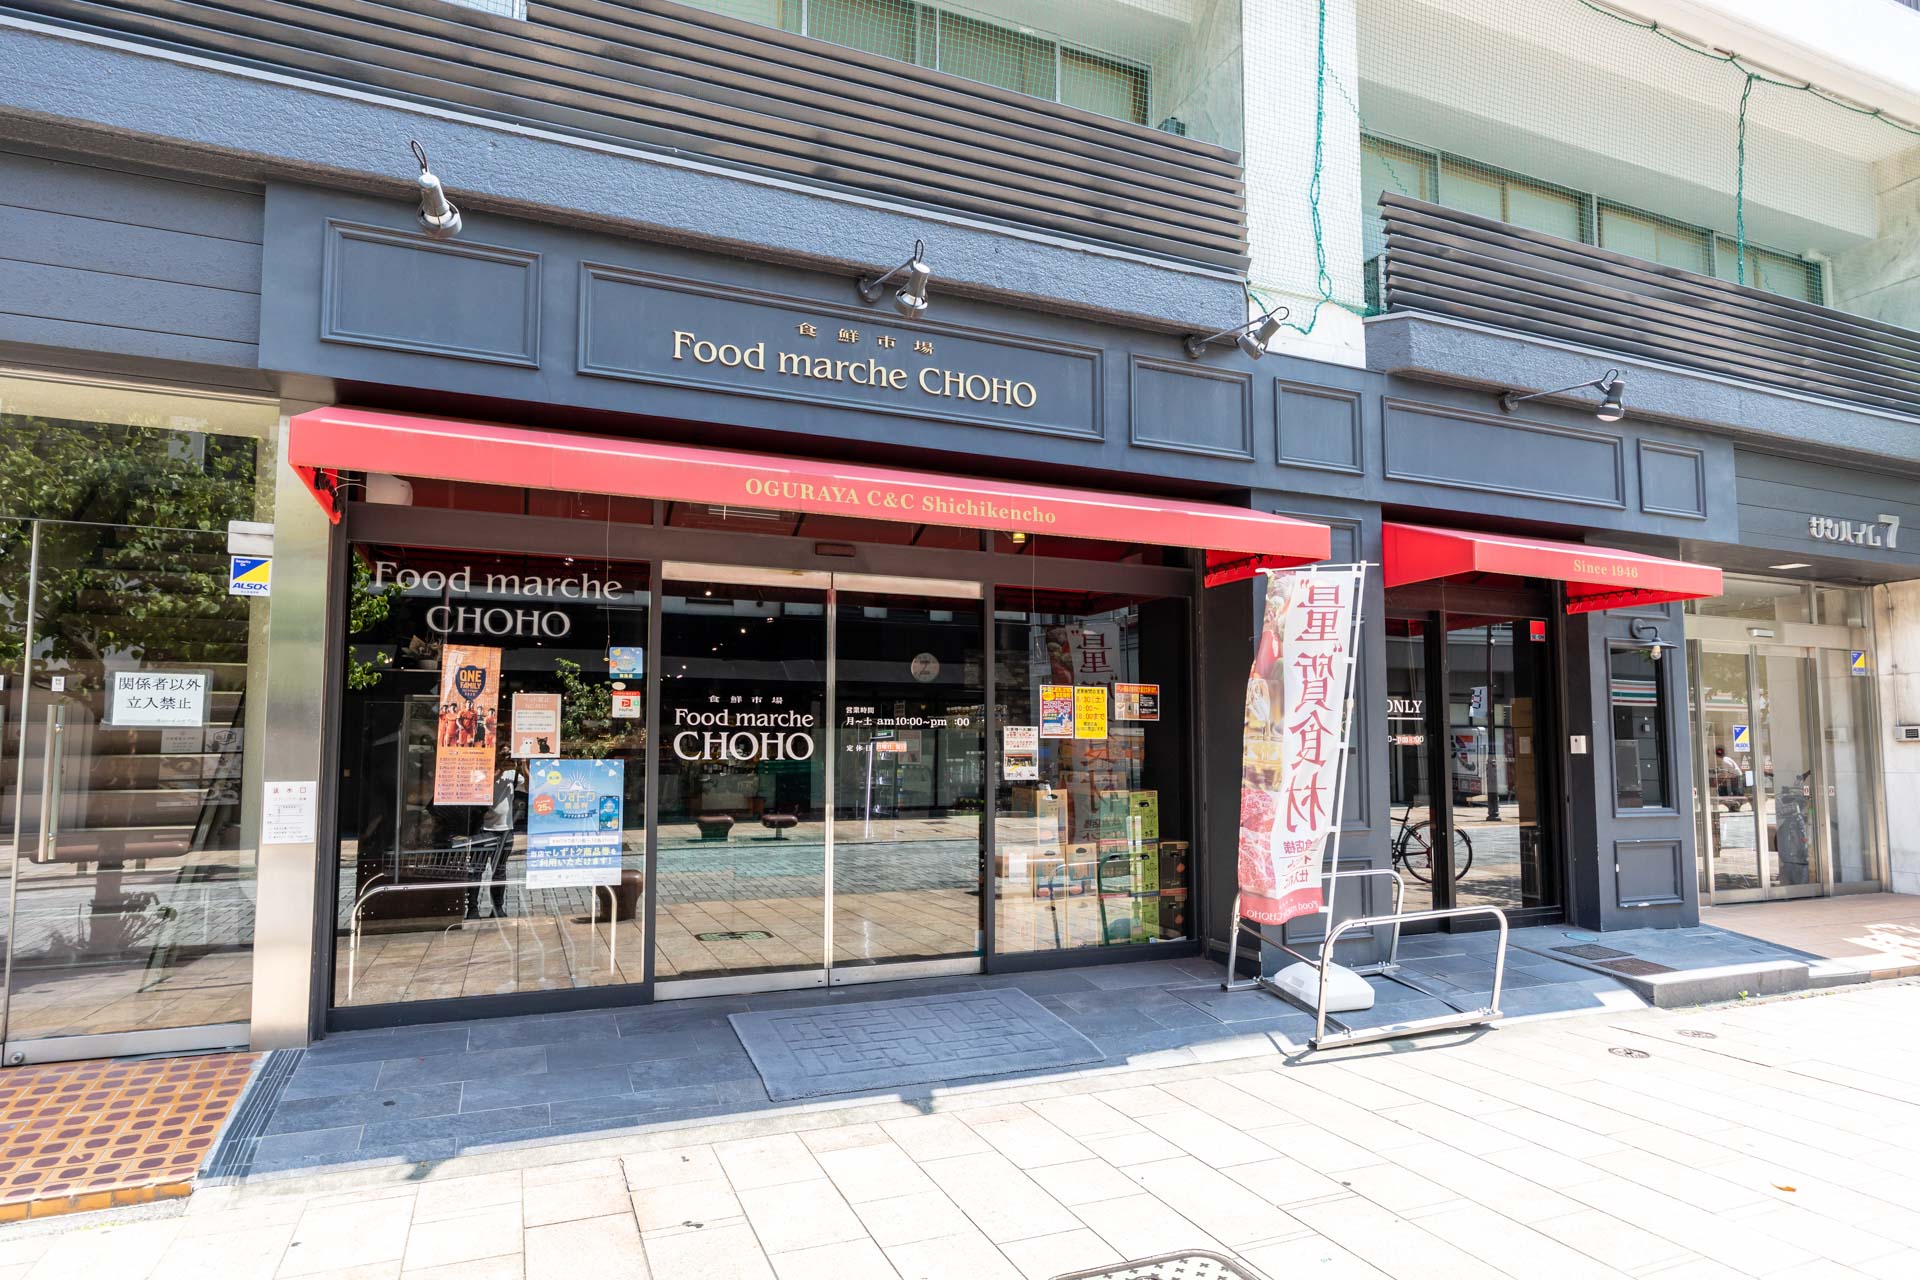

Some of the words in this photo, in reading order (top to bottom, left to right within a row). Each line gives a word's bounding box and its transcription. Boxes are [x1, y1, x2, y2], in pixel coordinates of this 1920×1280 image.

[797, 321, 935, 356] 食鮮市場
[672, 330, 766, 371] Food
[778, 350, 908, 390] marche
[918, 367, 1037, 408] CHOHO
[745, 478, 859, 506] OGURAYA
[867, 490, 916, 510] C&C
[922, 495, 1057, 525] Shichikencho
[1573, 559, 1608, 576] Since
[1611, 563, 1639, 578] 1946
[232, 582, 268, 591] ALSOK
[374, 560, 472, 593] Food
[486, 572, 623, 600] marche
[426, 605, 571, 637] CHOHO
[118, 677, 201, 691] 関係者以外
[459, 670, 482, 682] ONE
[126, 696, 192, 710] 立入禁止
[846, 706, 875, 714] 営業時間
[674, 708, 729, 726] Food
[735, 710, 814, 727] marche
[673, 731, 815, 761] CHOHO
